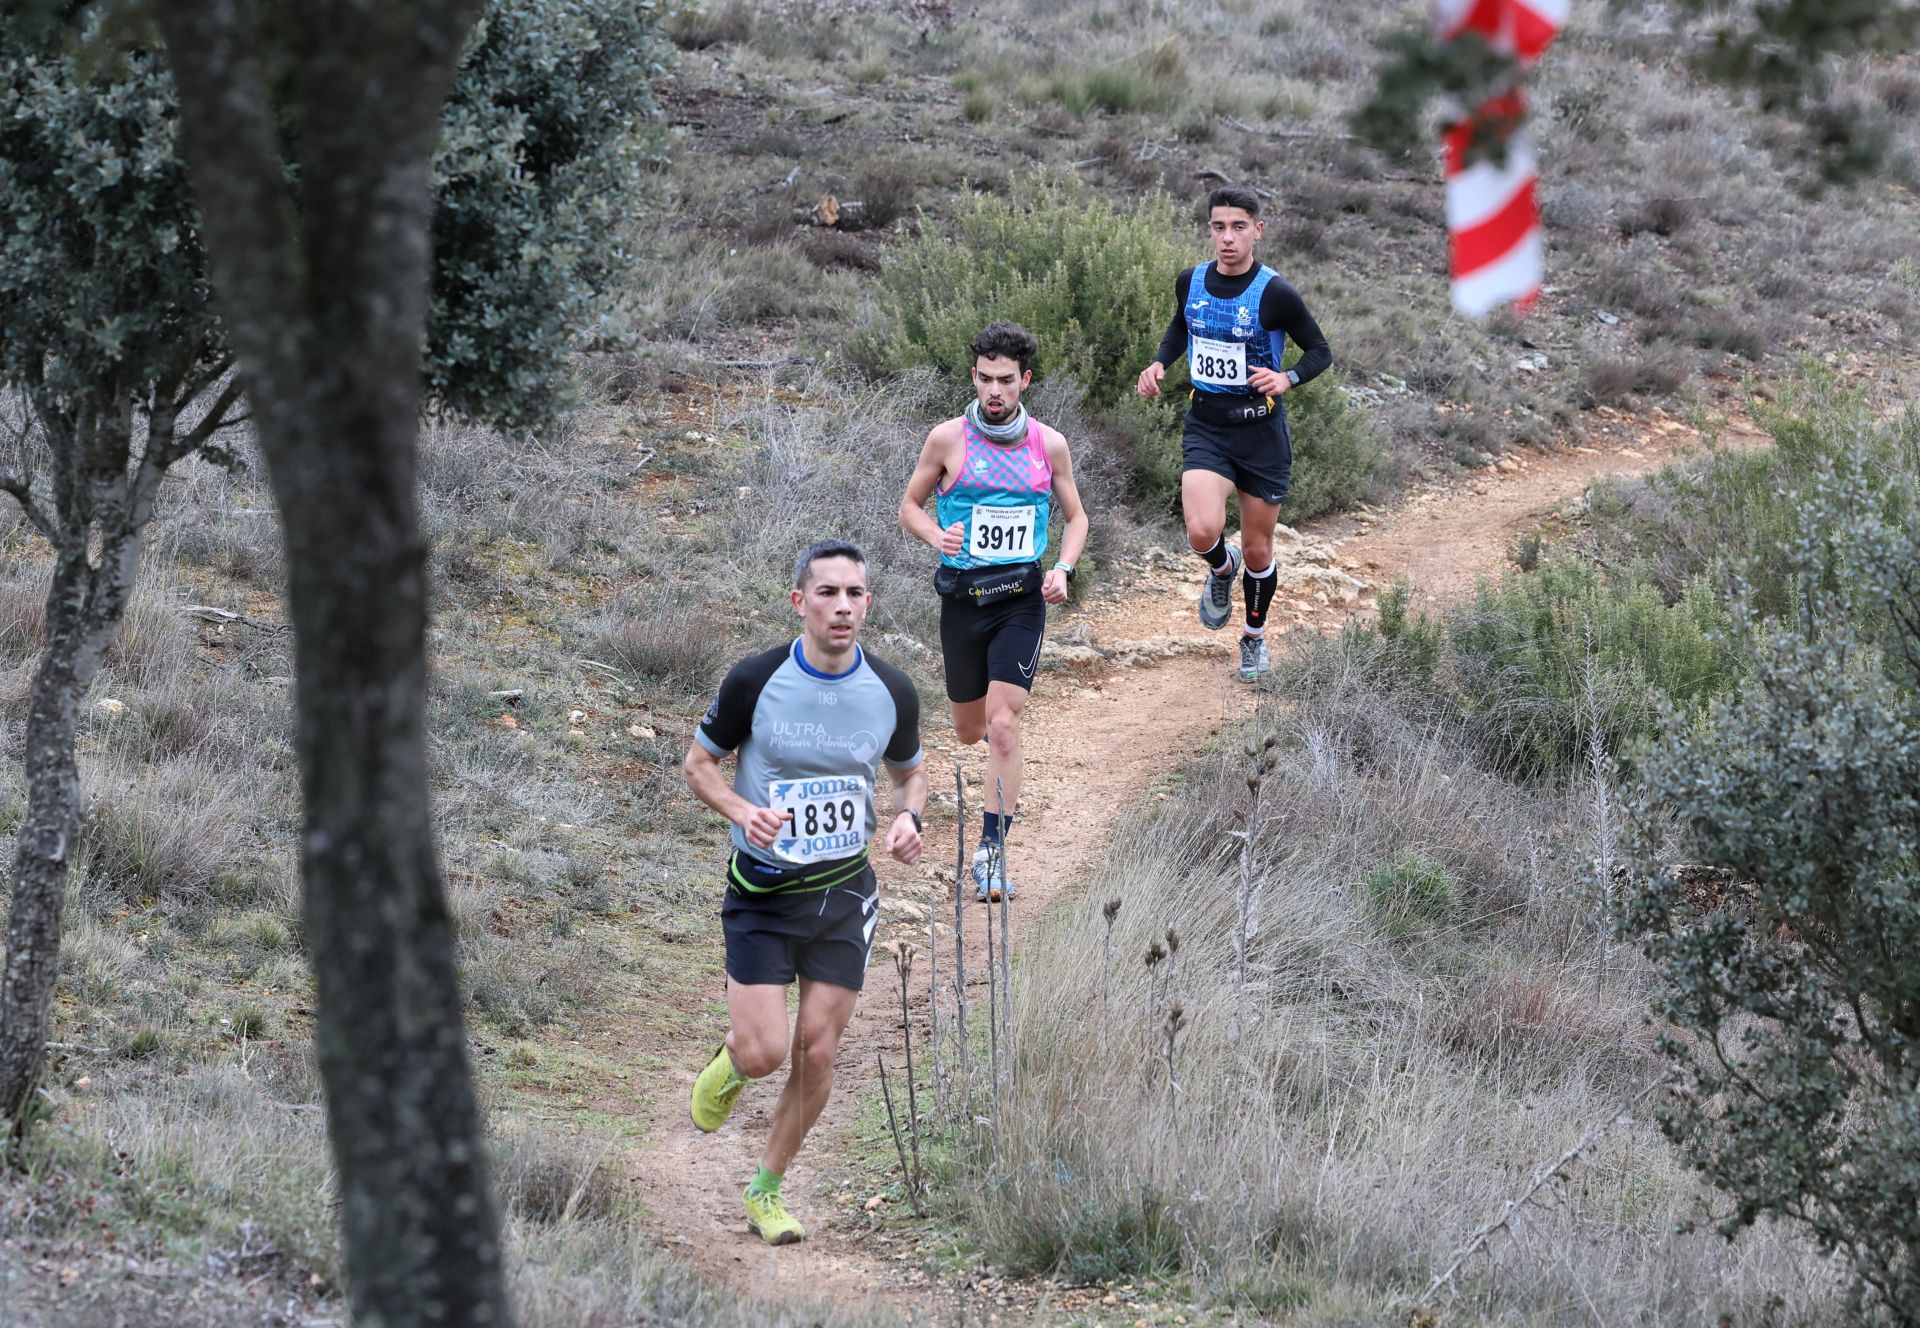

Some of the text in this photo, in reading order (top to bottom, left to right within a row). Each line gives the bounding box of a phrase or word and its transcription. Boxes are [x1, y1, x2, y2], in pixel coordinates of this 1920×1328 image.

[1197, 353, 1238, 380] 3833
[977, 524, 1027, 550] 3917
[968, 580, 1021, 596] Columbus
[772, 721, 826, 736] ULTRA
[787, 799, 856, 838] 1839
